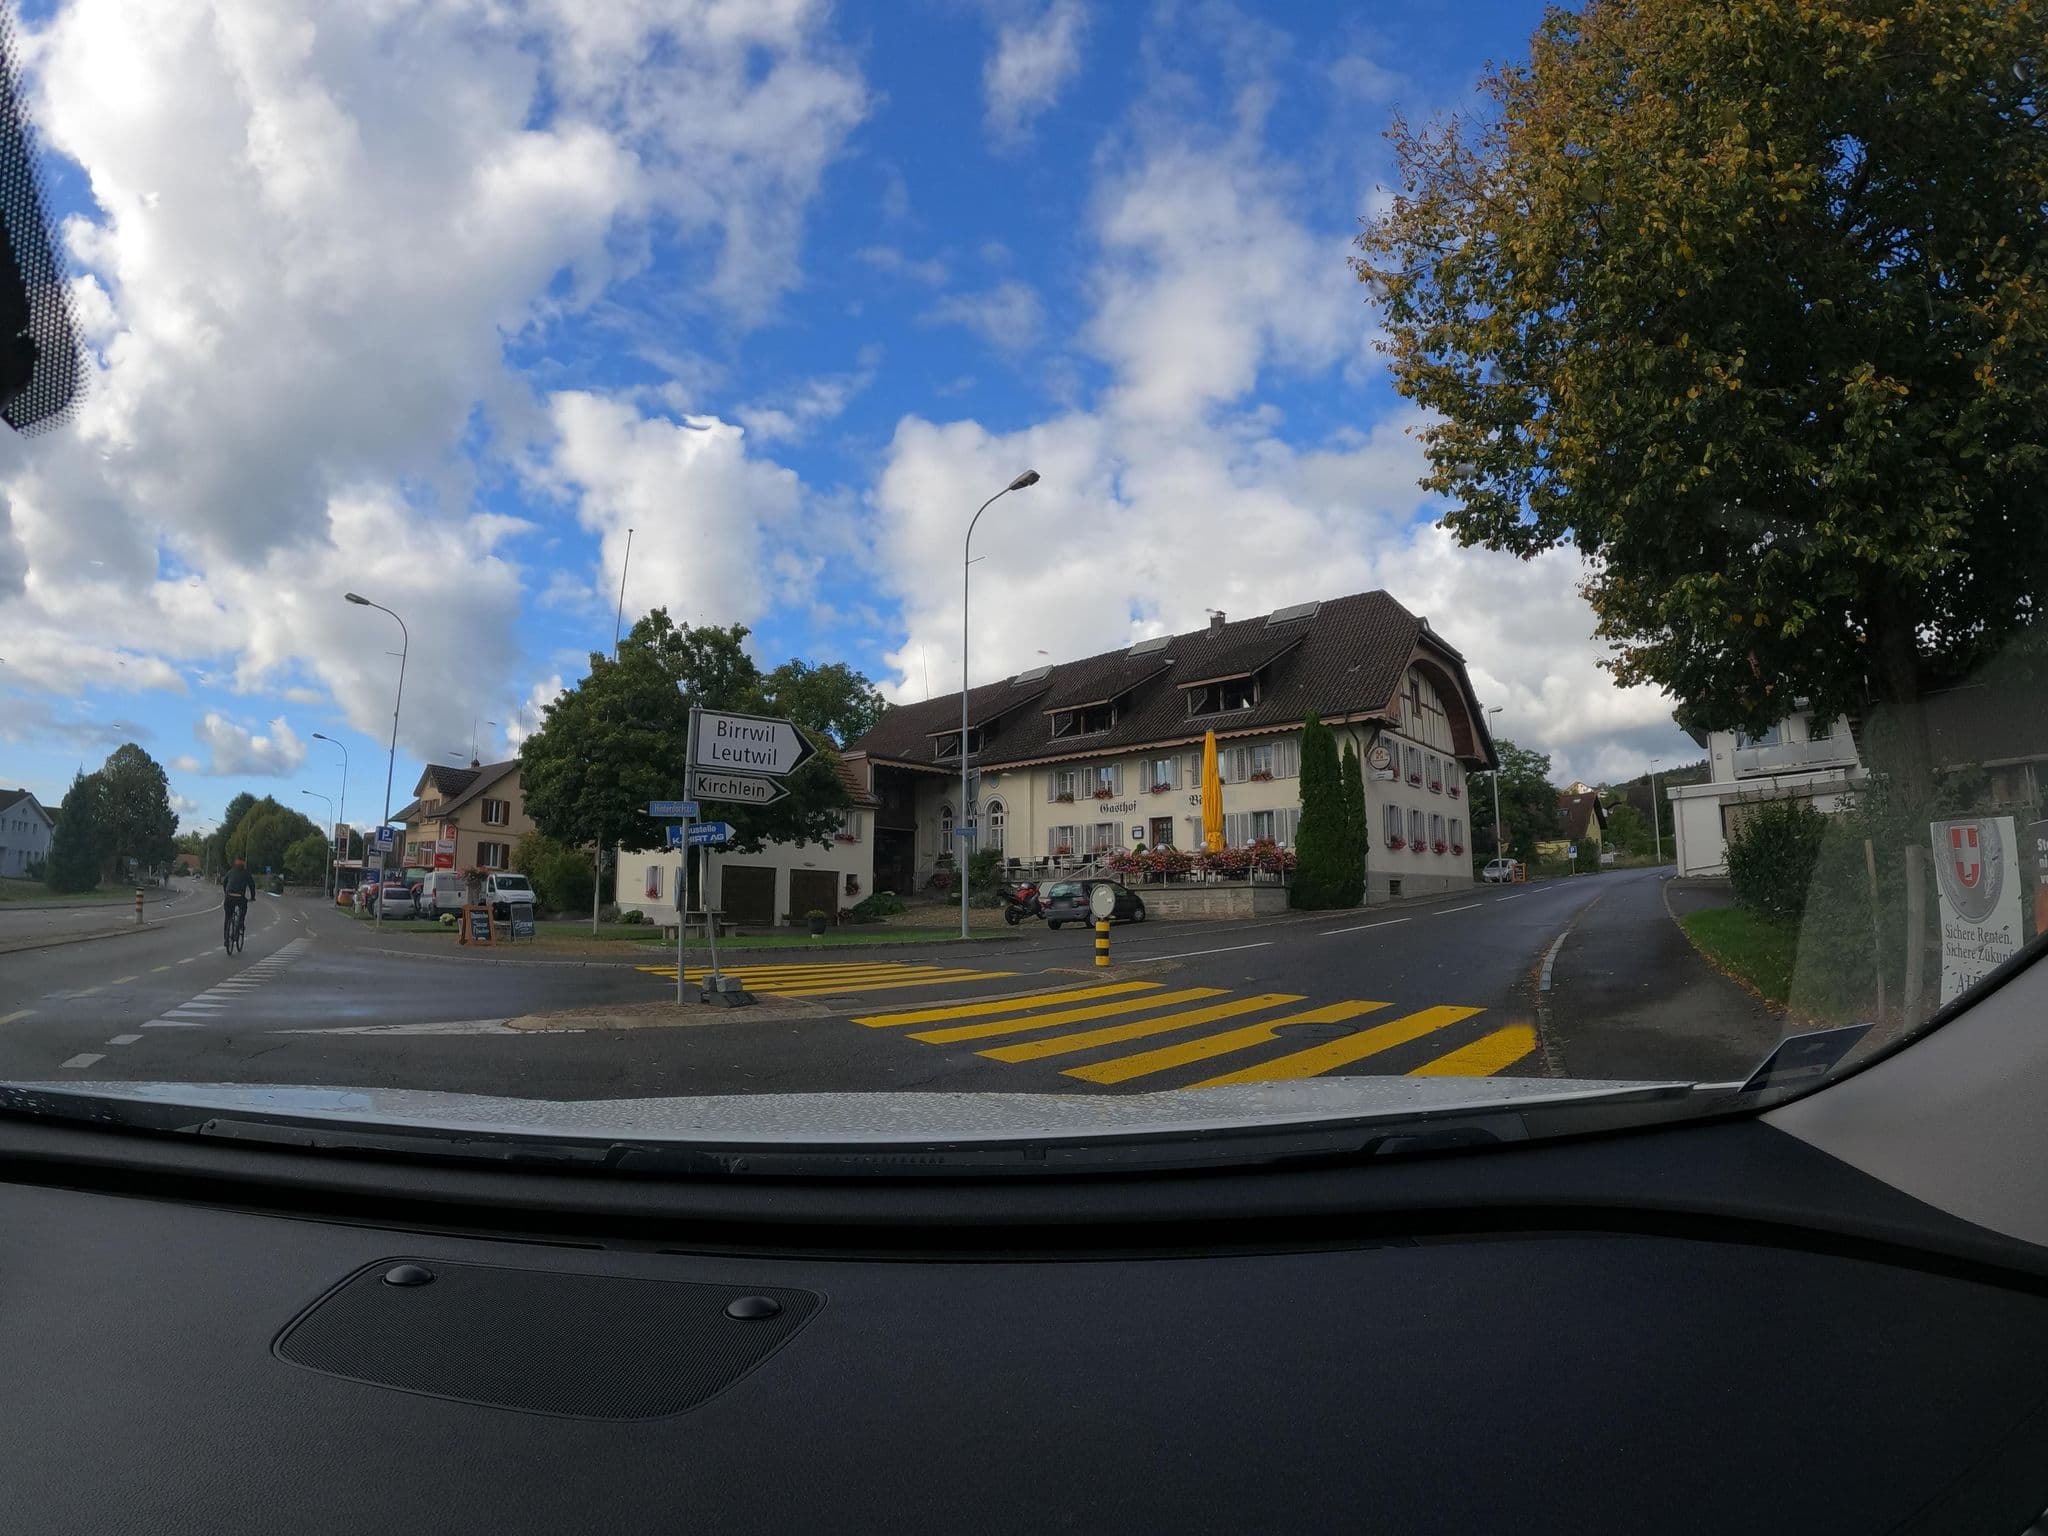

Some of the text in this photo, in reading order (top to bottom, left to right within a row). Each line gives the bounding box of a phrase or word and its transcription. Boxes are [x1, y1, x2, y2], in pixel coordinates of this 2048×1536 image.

[717, 720, 775, 743] Birrwil
[712, 743, 777, 766] Leutwil
[698, 777, 765, 797] Kirchlein
[1099, 800, 1137, 814] Gasthof
[710, 833, 725, 841] AG
[1945, 923, 2013, 944] Sichere Renten.
[1946, 942, 1976, 959] Sichere
